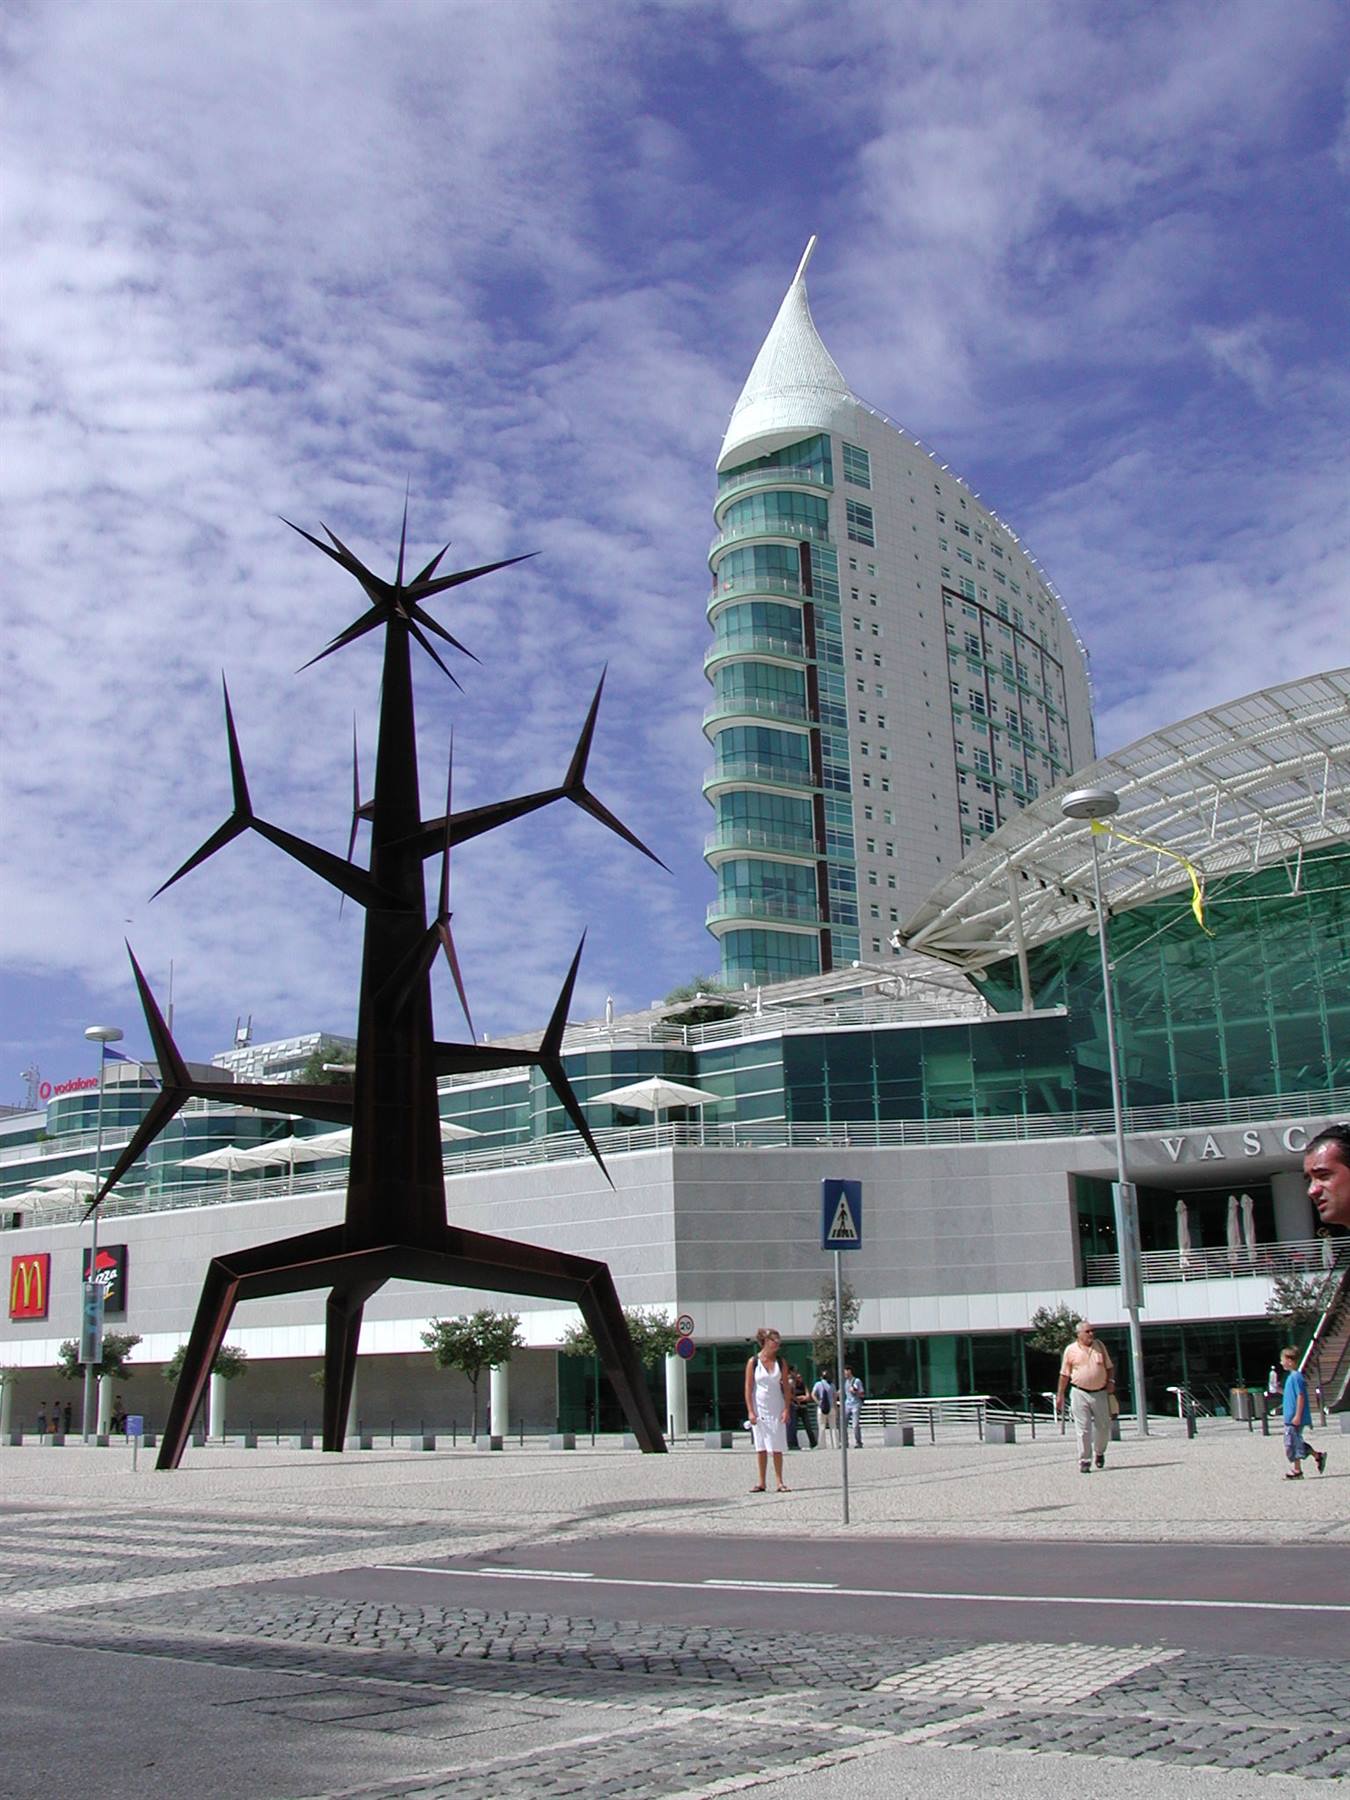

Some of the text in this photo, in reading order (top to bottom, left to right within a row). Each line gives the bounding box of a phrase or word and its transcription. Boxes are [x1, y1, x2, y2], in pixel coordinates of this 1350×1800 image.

[54, 1077, 98, 1096] vodafone
[1160, 1121, 1350, 1162] VASC
[680, 1321, 691, 1330] 20
